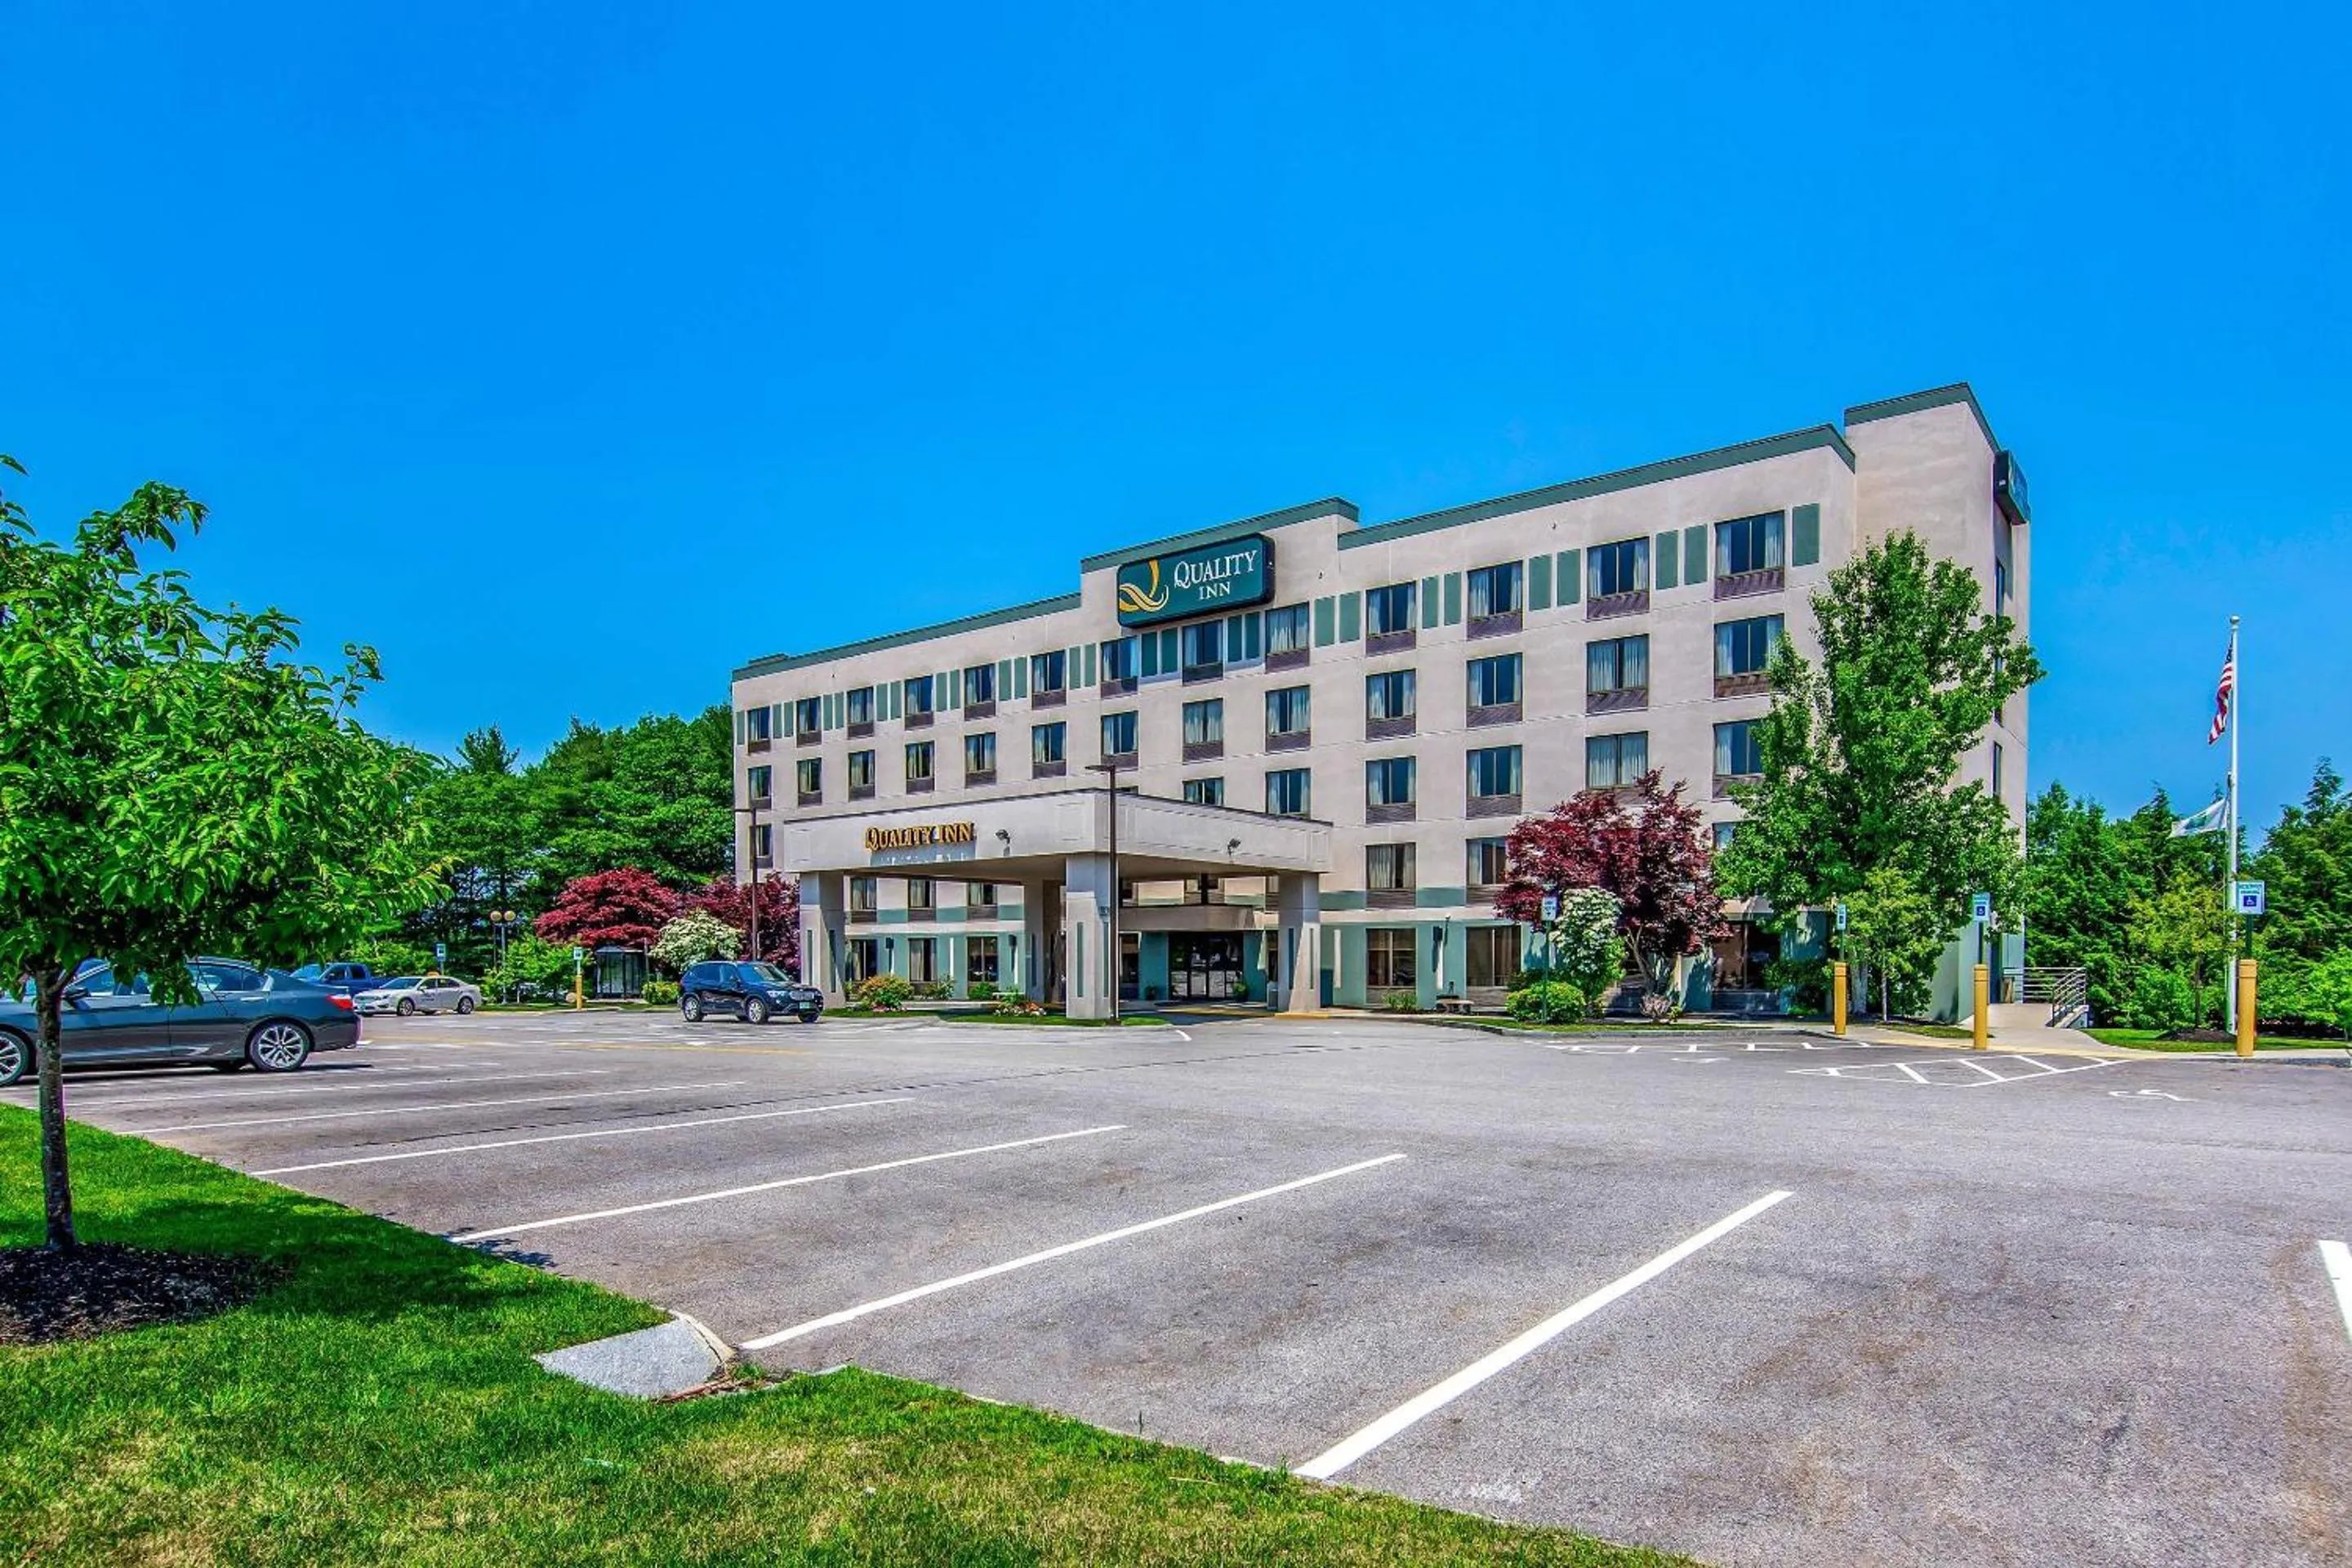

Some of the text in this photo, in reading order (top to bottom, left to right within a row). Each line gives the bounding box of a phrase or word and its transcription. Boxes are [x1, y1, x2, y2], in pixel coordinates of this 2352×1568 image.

[1174, 550, 1257, 588] QUALITY
[1199, 581, 1231, 599] INN
[866, 822, 973, 851] QUALITY INN
